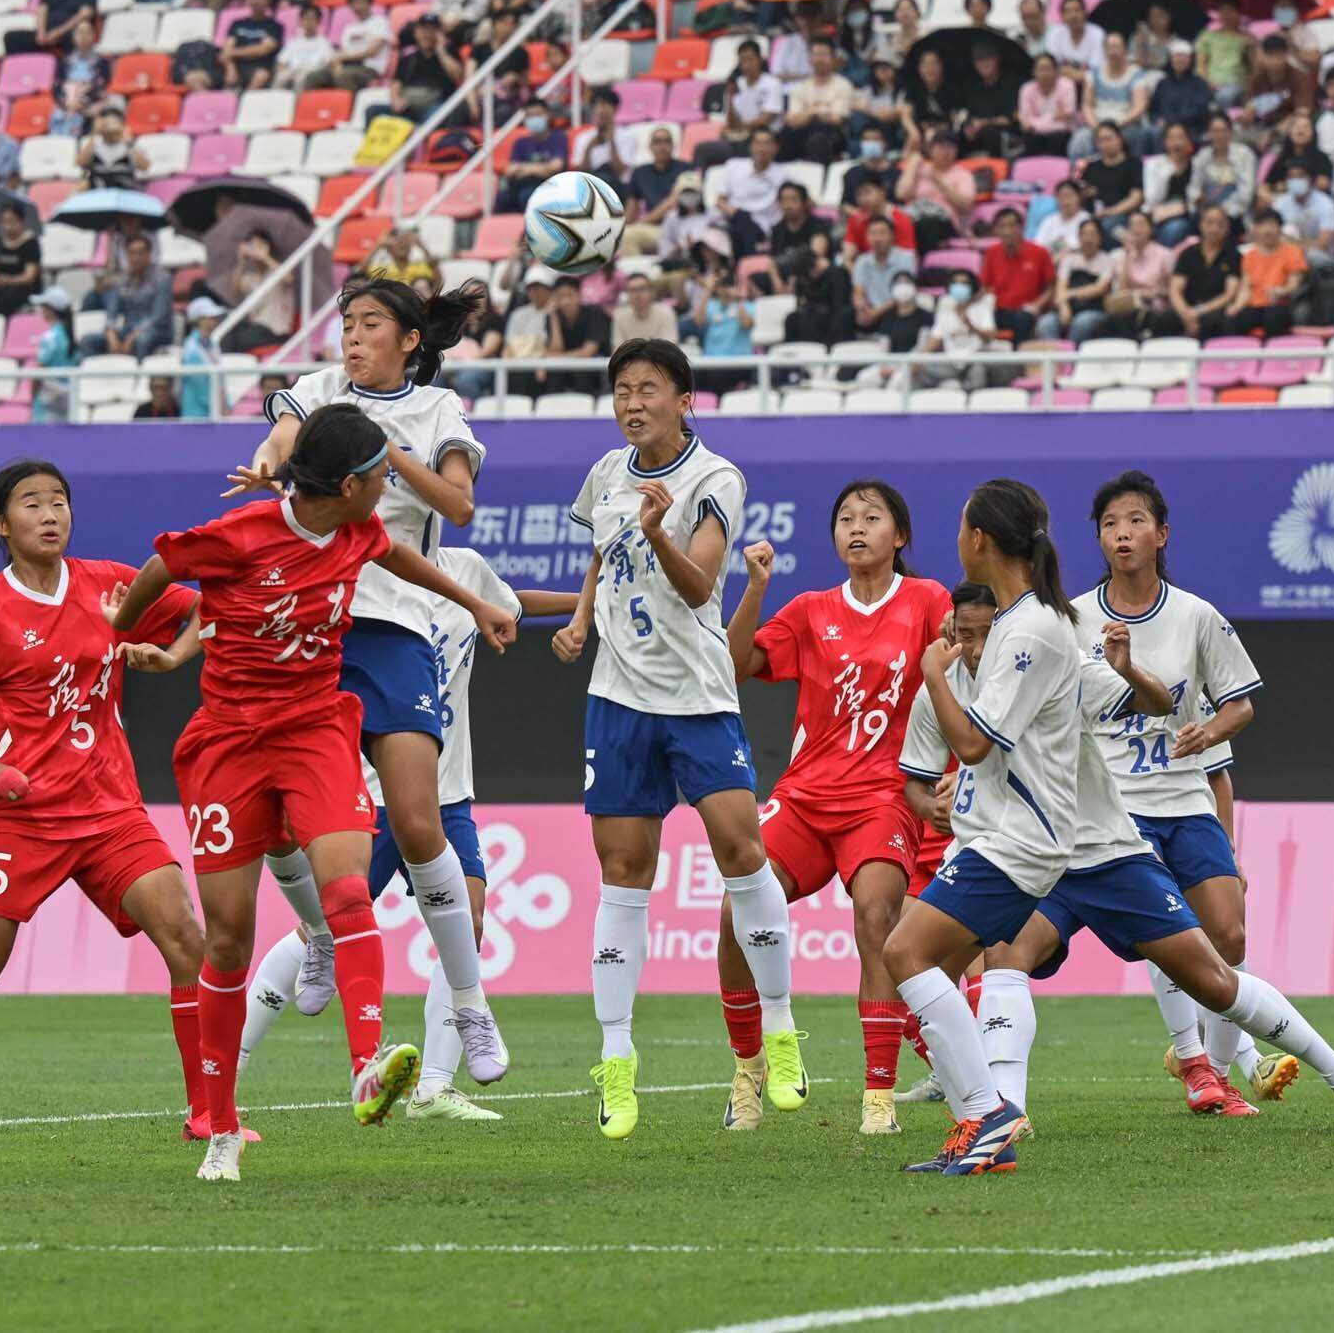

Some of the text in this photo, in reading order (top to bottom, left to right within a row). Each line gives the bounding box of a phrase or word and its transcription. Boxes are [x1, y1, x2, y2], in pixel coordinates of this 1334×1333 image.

[630, 595, 653, 637] 5
[70, 703, 96, 750] 5
[847, 709, 889, 752] 19
[1128, 733, 1170, 774] 24
[953, 768, 976, 815] 13
[189, 802, 234, 857] 23
